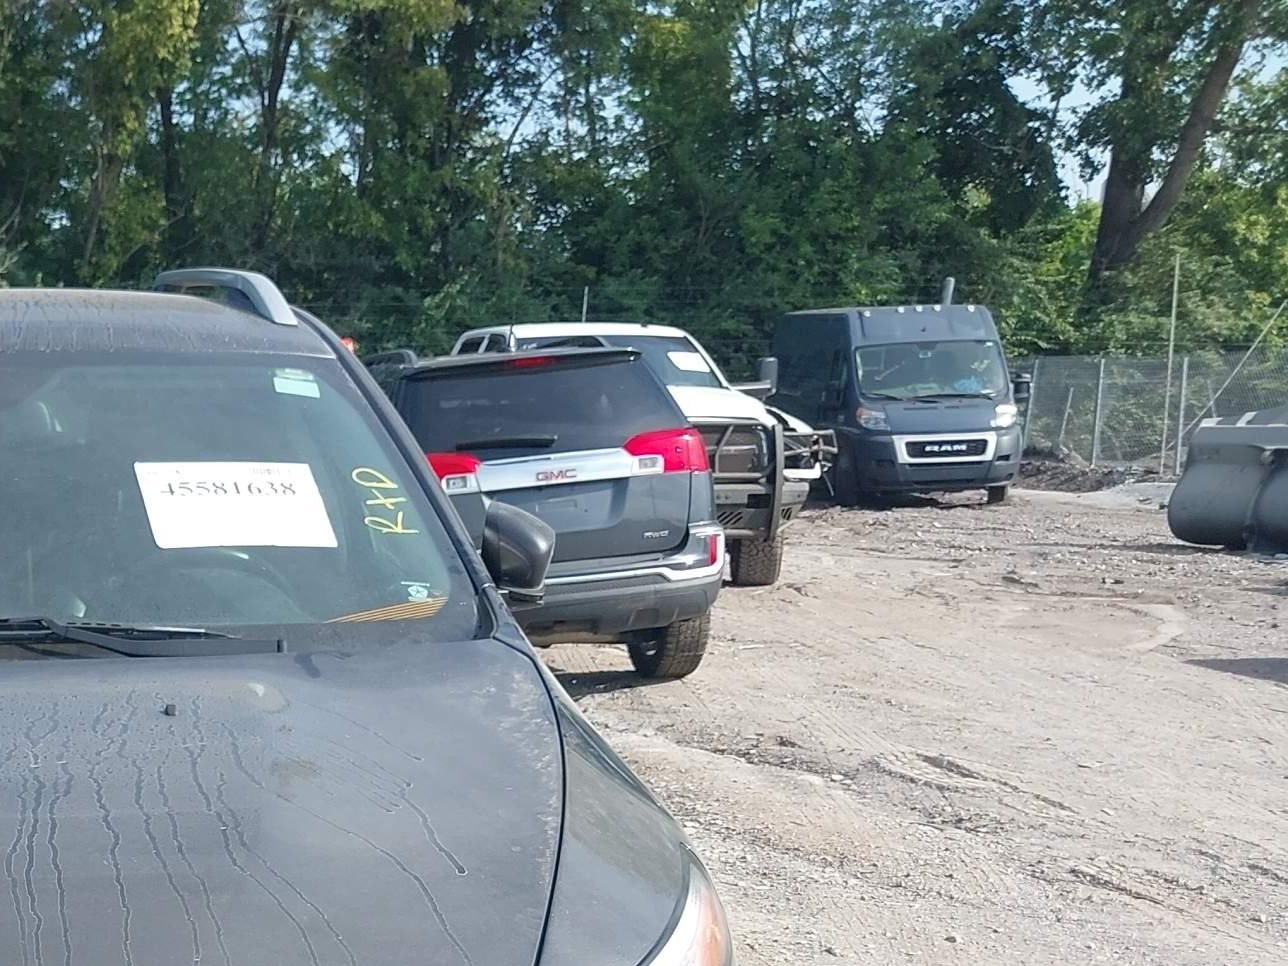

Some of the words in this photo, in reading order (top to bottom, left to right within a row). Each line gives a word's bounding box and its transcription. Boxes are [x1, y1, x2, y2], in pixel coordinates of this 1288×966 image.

[924, 444, 968, 452] RAM
[536, 469, 577, 481] GMC
[161, 482, 296, 496] 45581638
